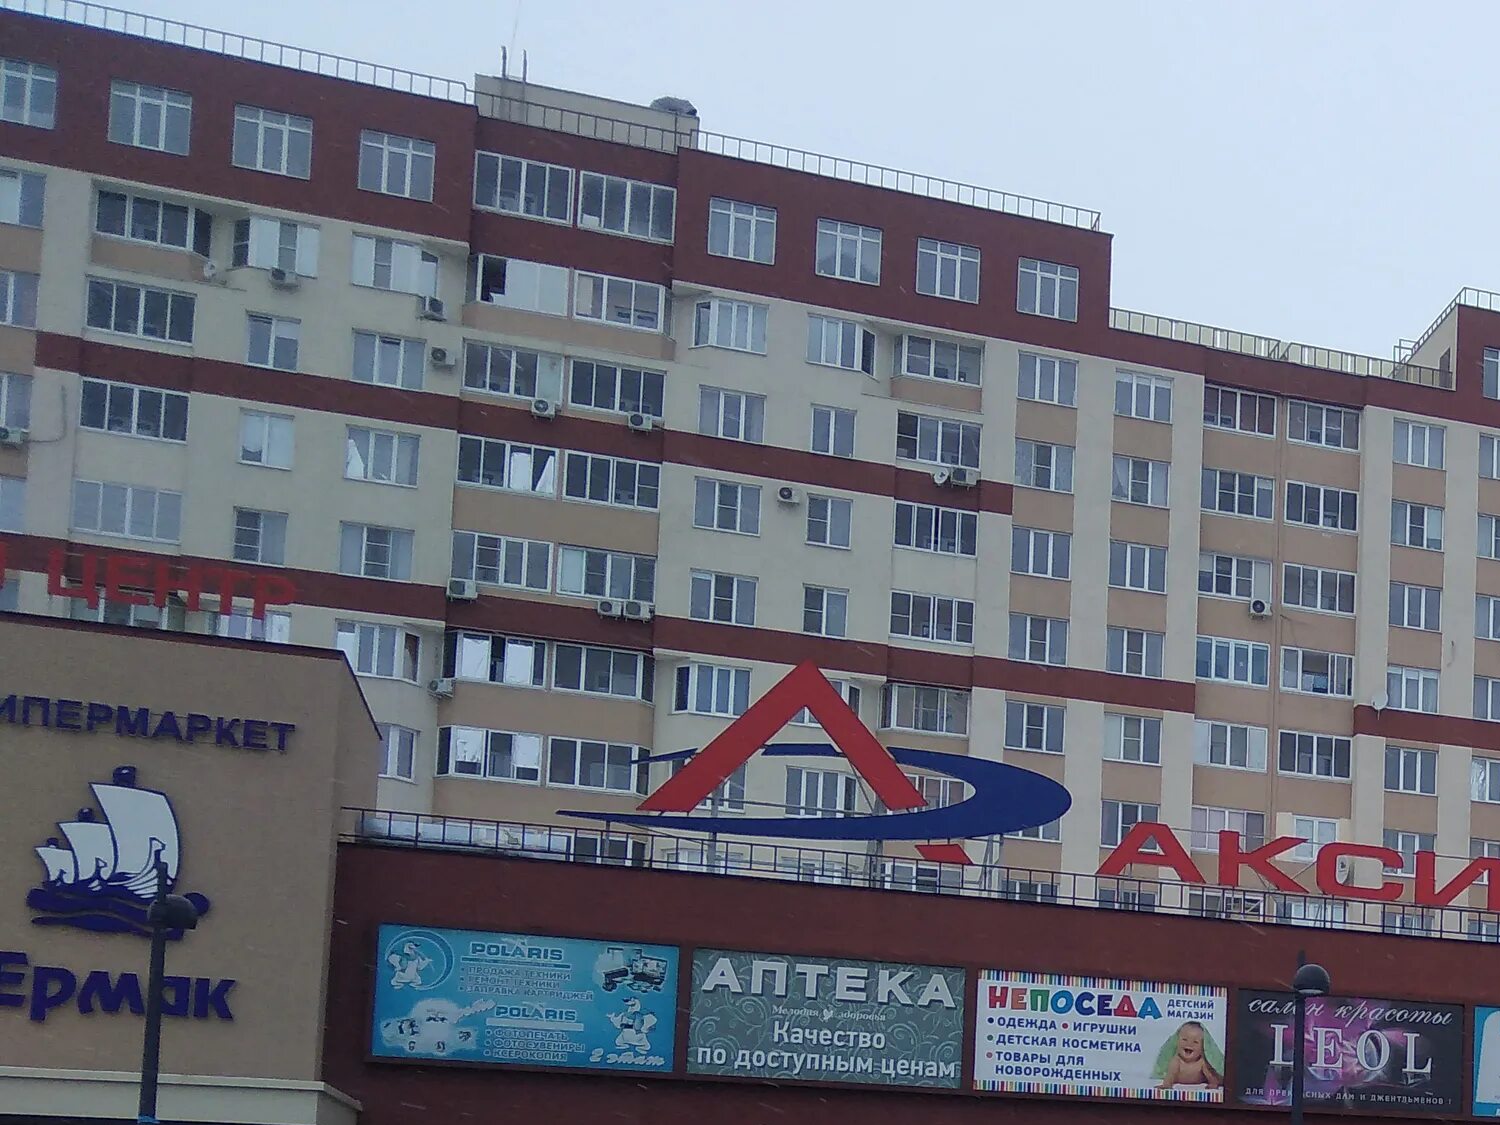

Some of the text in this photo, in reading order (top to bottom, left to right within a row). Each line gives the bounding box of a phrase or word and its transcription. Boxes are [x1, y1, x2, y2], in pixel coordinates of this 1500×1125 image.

[47, 548, 297, 620] ЦЕНТР
[471, 942, 564, 960] POLARIS
[702, 957, 956, 1008] АПТЕКА
[988, 985, 1162, 1019] НЕПОСЕДА
[1167, 999, 1214, 1010] ДЕТСКИЙ
[496, 1006, 576, 1021] POLARIS
[1167, 1010, 1214, 1020] МАГАЗИН
[1335, 1000, 1453, 1028] красоты
[495, 1028, 569, 1041] ФОТОПЕЧАТЬ
[774, 1021, 887, 1049] Качество
[997, 1017, 1137, 1036] ОДЕЖДА ИГРУШКИ
[493, 1039, 586, 1053] ФОТОСУВЕНИРЫ
[996, 1034, 1141, 1053] ДЕТСКАЯ КОСМЕТИКА
[493, 1049, 568, 1062] КСЕРОКОПИЯ
[589, 1048, 604, 1062] 2
[697, 1048, 956, 1078] по доступным ценам
[995, 1051, 1084, 1066] ТОВАРЫ ДЛЯ
[995, 1065, 1122, 1082] НОВОРОЖДЕННЫХ
